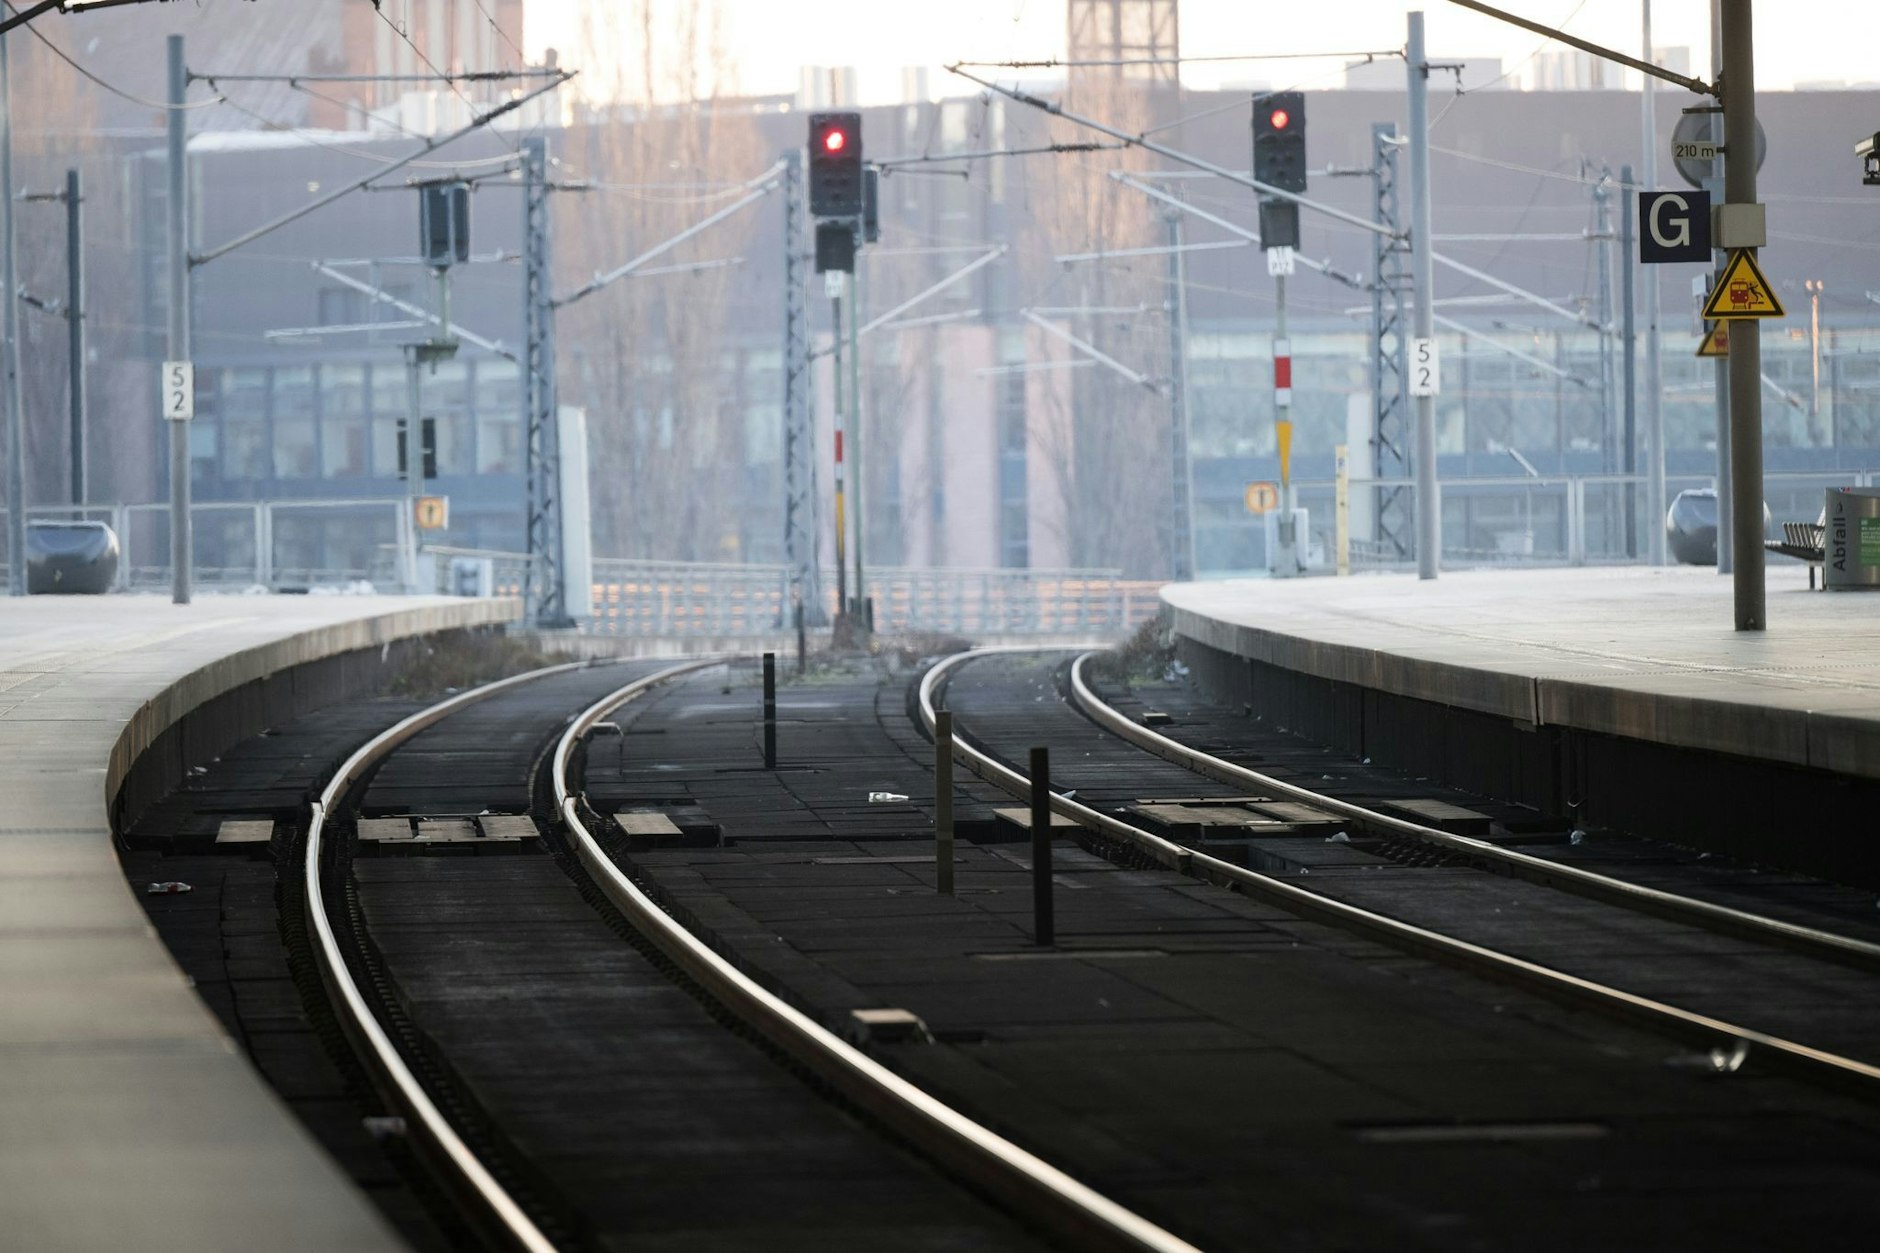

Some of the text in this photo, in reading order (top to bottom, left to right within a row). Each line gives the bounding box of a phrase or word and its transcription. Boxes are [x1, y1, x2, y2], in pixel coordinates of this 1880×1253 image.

[1676, 144, 1714, 157] 210 m
[1649, 193, 1690, 248] G
[1418, 343, 1430, 363] 5
[172, 366, 185, 388] 5
[1418, 367, 1430, 387] 2
[173, 390, 185, 411] 2
[1833, 517, 1847, 572] Abfall
